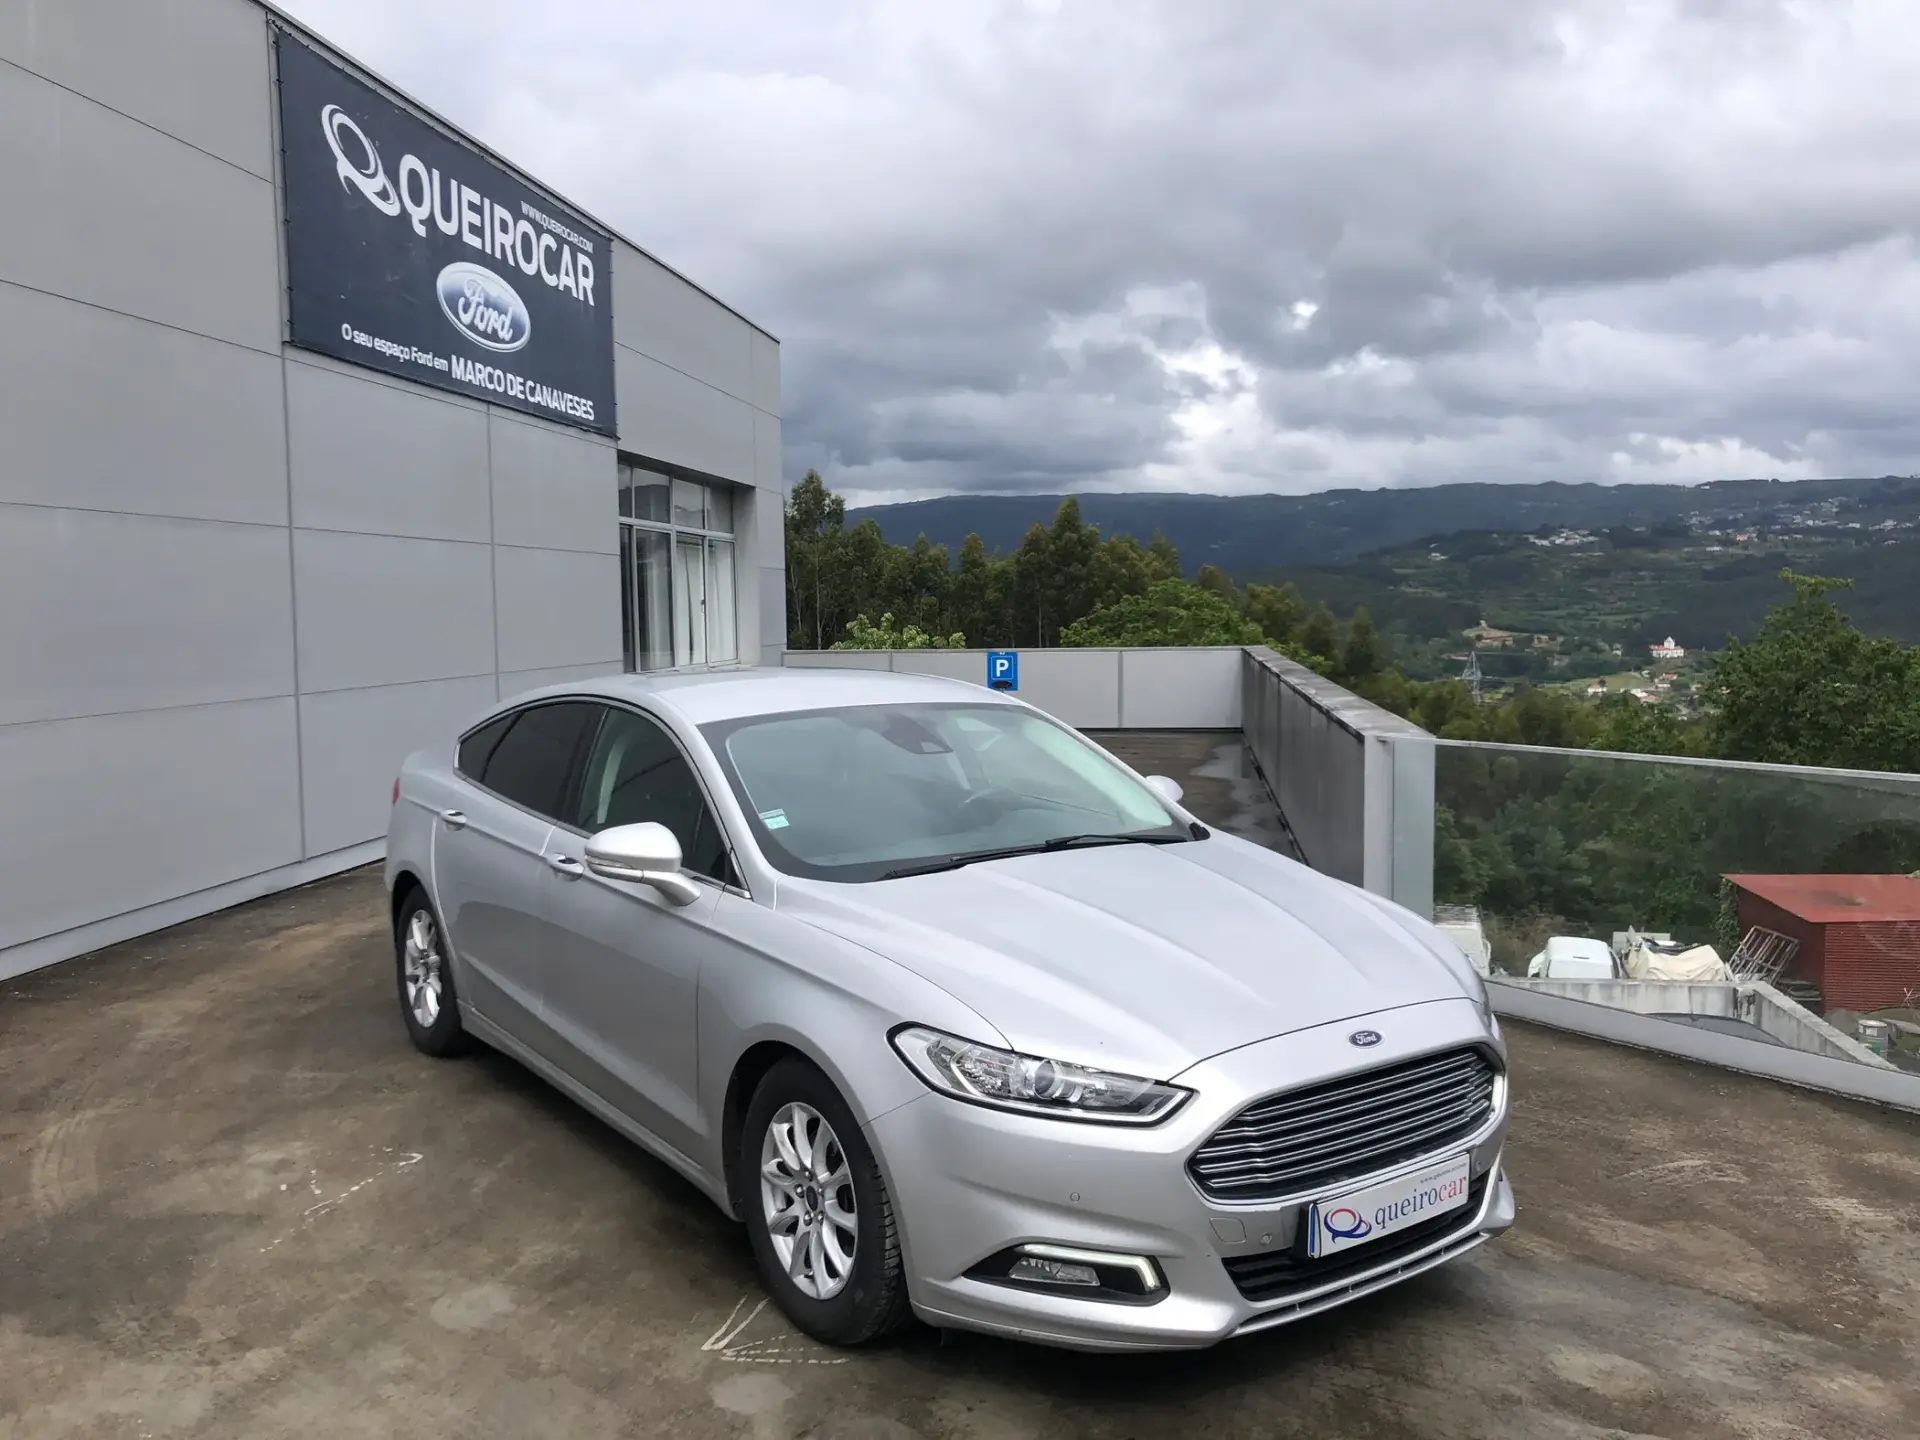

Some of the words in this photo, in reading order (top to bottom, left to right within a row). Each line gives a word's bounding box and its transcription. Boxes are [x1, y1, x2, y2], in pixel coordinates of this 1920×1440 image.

[399, 153, 596, 307] QUEIROCAR
[457, 276, 514, 342] Ford
[341, 323, 353, 341] O
[353, 330, 373, 348] seu
[373, 337, 410, 362] espaço
[411, 346, 433, 367] Ford
[433, 356, 449, 372] em
[451, 354, 506, 393] MARCO
[506, 372, 526, 400] DE
[525, 380, 595, 421] CANAVESES
[996, 659, 1009, 678] P
[1355, 1032, 1377, 1044] Ford
[1375, 1175, 1467, 1230] queirocar
